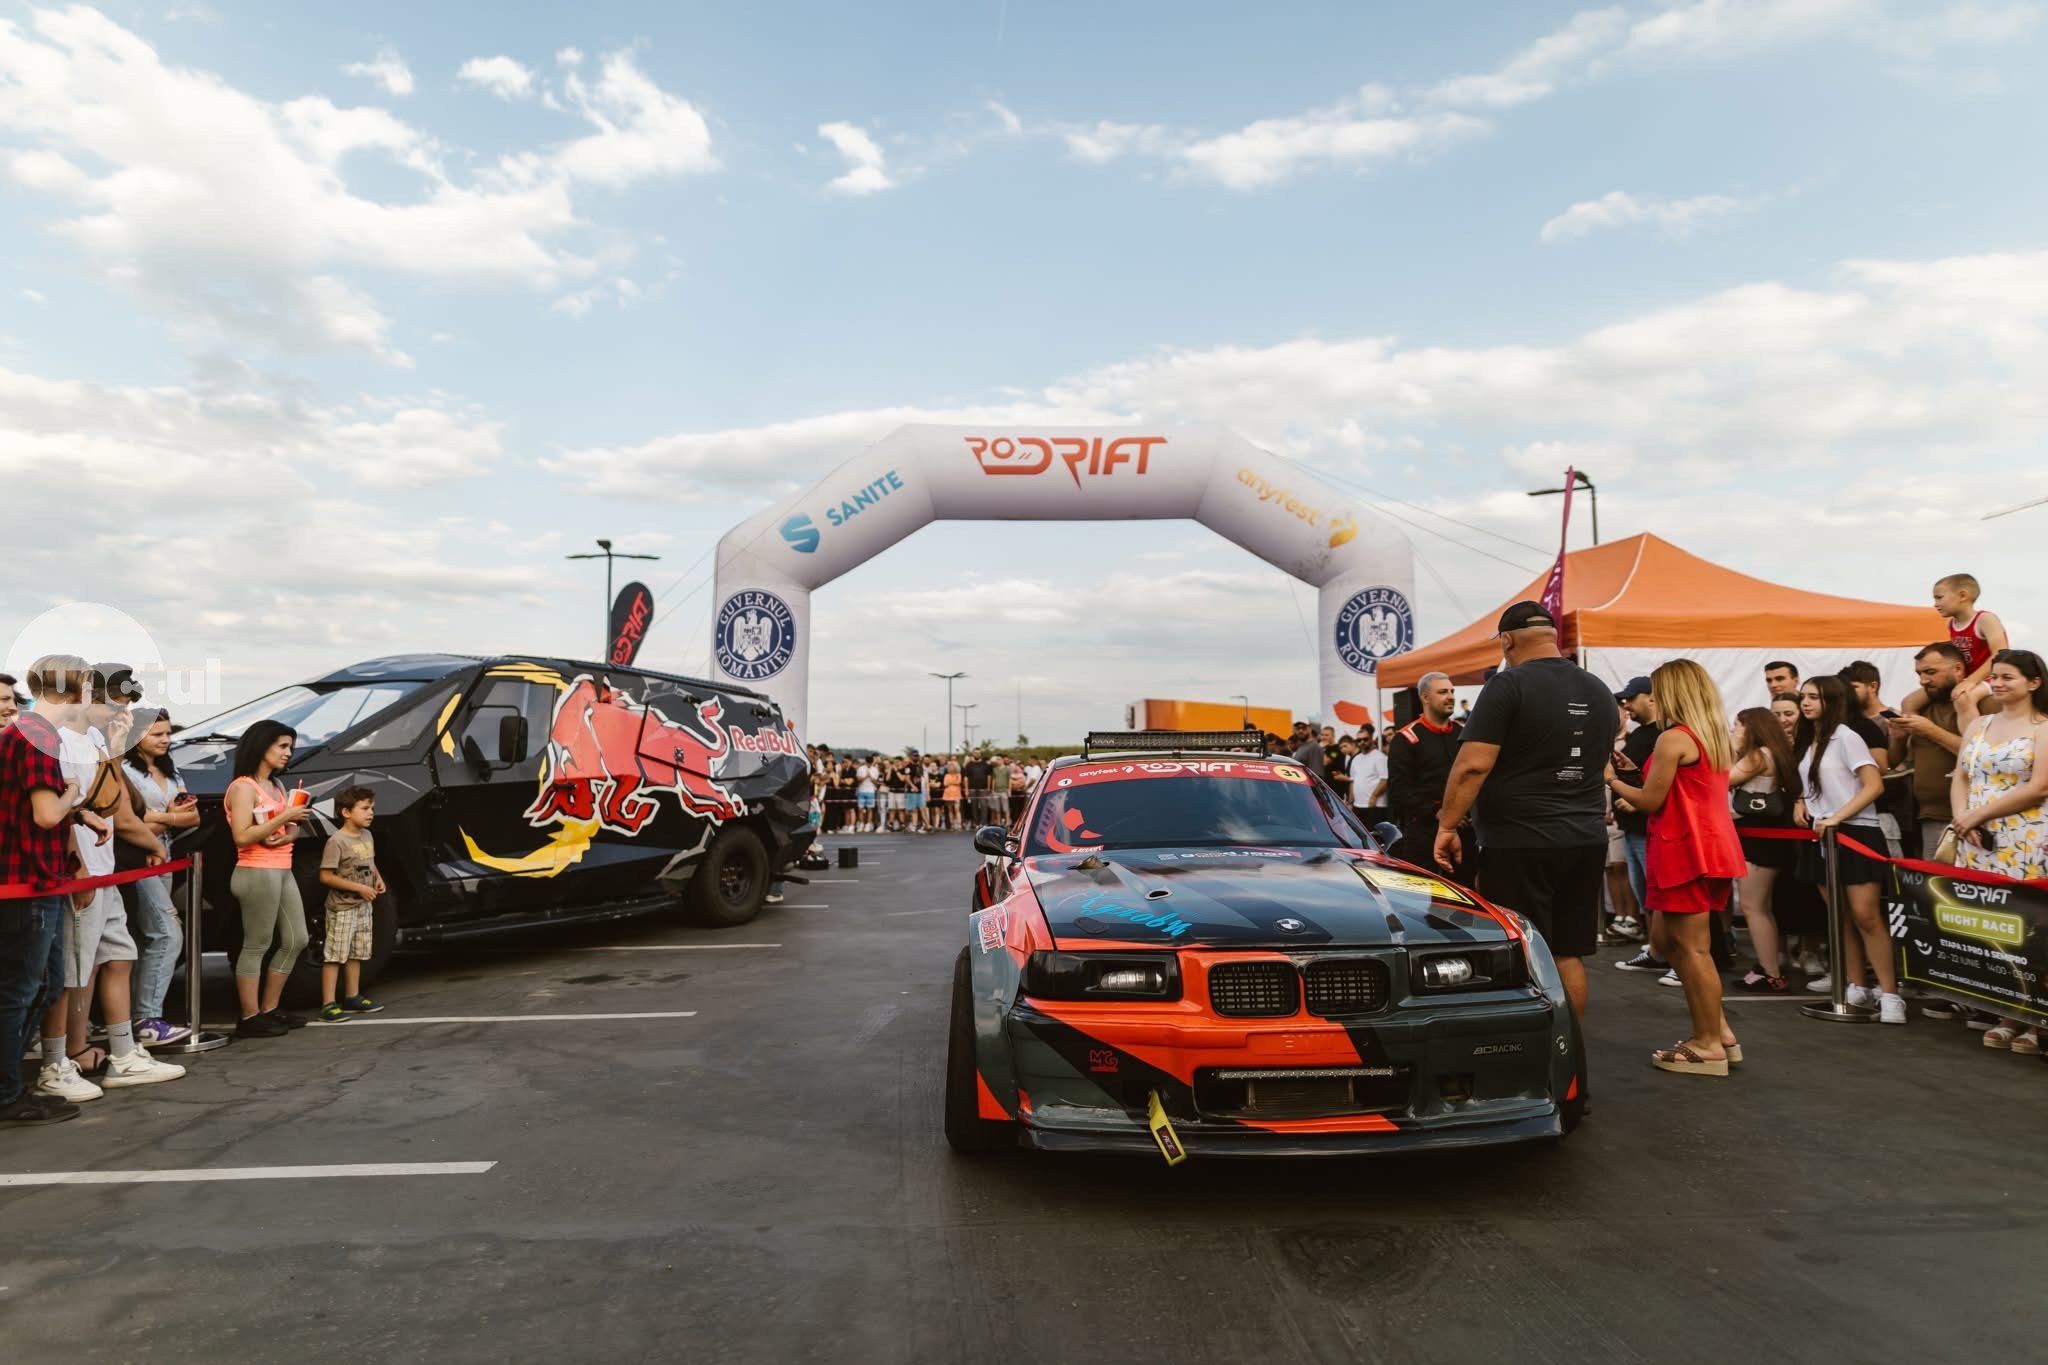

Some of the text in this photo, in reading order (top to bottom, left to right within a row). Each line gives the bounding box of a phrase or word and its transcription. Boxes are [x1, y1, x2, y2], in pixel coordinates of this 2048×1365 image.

[964, 437, 1169, 490] RODRIFT
[826, 470, 904, 526] SANITE
[1236, 467, 1321, 527] anyfest
[719, 592, 792, 628] GUVERNUL
[1340, 590, 1412, 623] GUVERNUL
[729, 725, 798, 755] Red Bull
[1079, 768, 1118, 777] anyfest
[1136, 761, 1240, 775] RODRIFT
[1281, 768, 1301, 778] 31
[1952, 882, 2012, 905] RODRIFT
[1941, 911, 1979, 928] NIGHT
[1981, 919, 2016, 935] RACE
